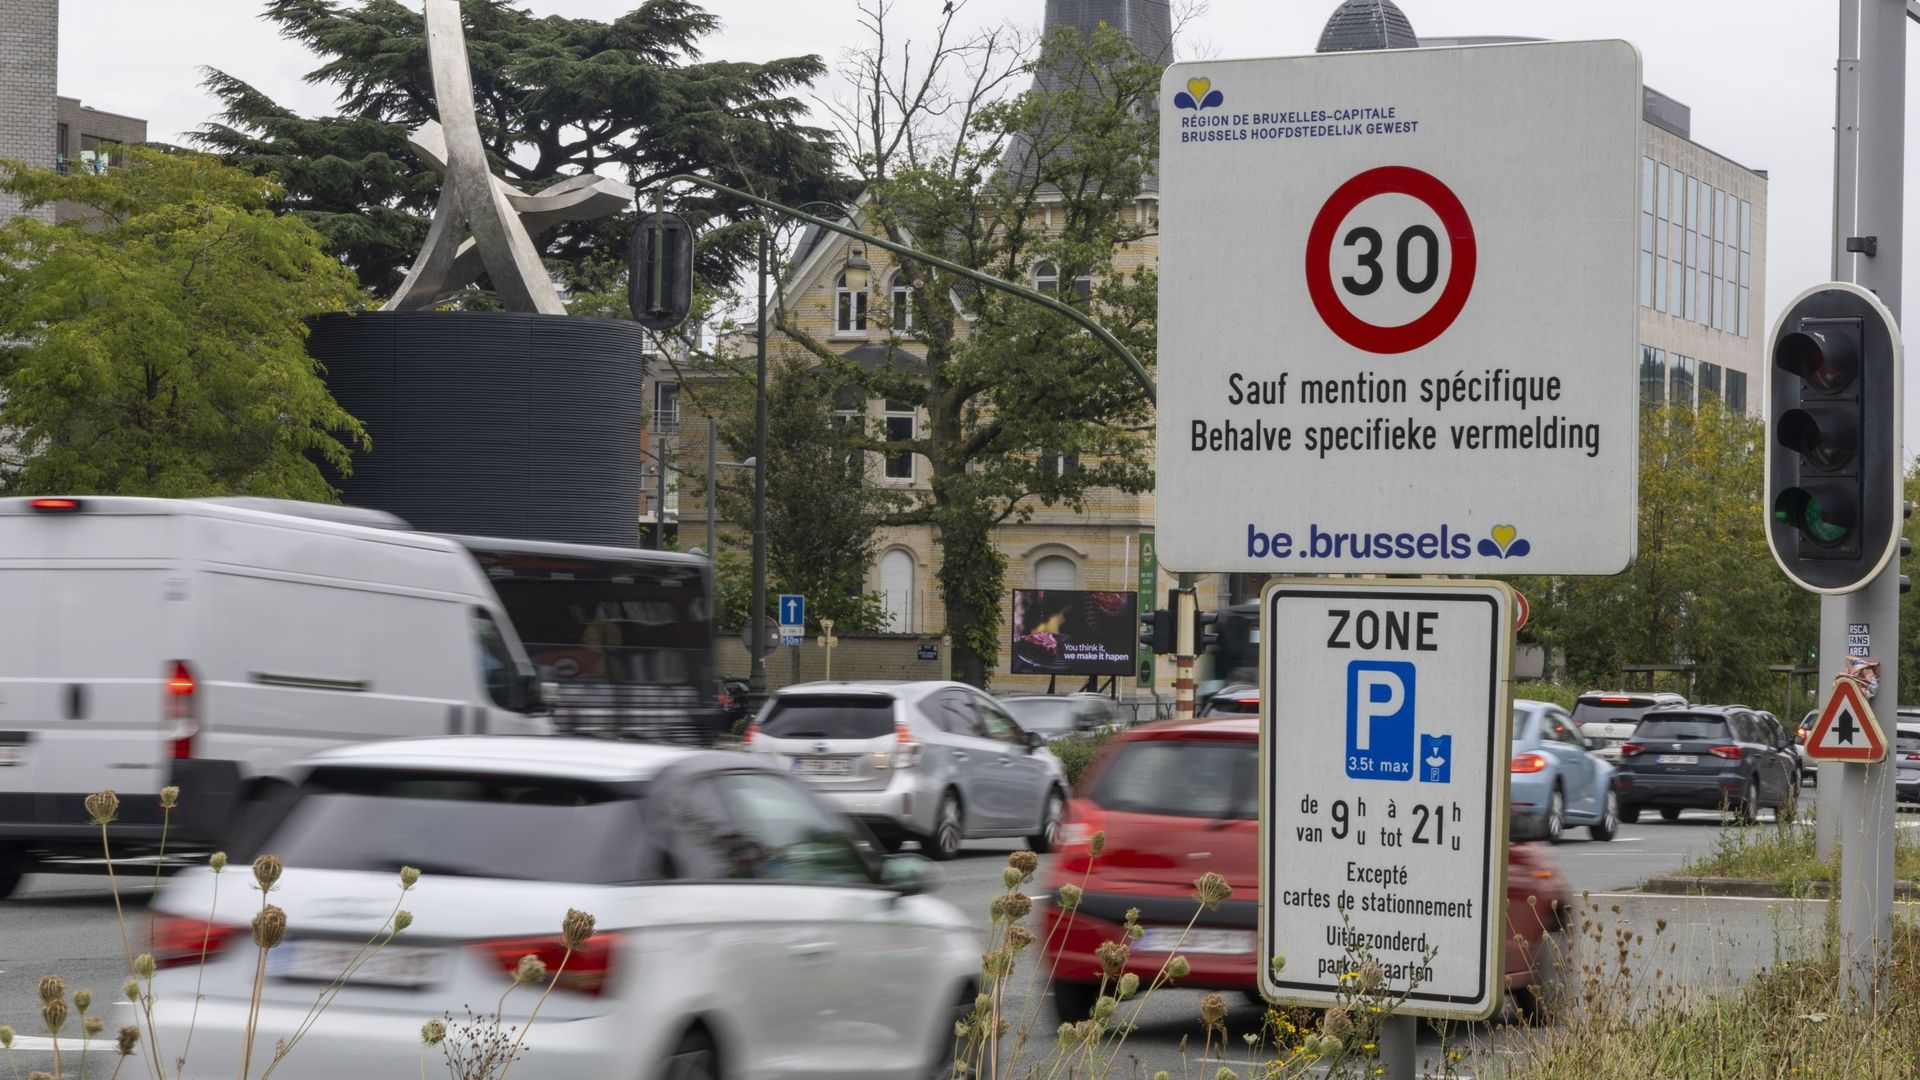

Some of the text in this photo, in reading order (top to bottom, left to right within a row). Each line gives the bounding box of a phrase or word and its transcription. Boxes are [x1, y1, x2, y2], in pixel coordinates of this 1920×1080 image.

[1181, 114, 1229, 128] RÉGION
[1233, 114, 1249, 126] DE
[1181, 121, 1419, 143] BRUSSELS HOOFDSTEDELIJK GEWEST
[1341, 224, 1439, 297] 30
[1228, 368, 1561, 410] Sauf mention spécifique
[1191, 415, 1600, 460] Behalve specifieke vermelding
[1247, 523, 1472, 560] be.brussels
[1327, 609, 1439, 652] ZONE
[1850, 625, 1868, 634] RSCA
[1850, 636, 1868, 645] FANS
[1064, 643, 1078, 651] You
[1079, 643, 1098, 651] think
[1077, 652, 1098, 660] make
[1099, 652, 1104, 660] it
[1105, 652, 1129, 662] hapen
[1850, 647, 1868, 656] AREA
[1356, 669, 1405, 751] P
[1348, 756, 1409, 773] 3.5t max
[1301, 793, 1461, 845] de 9 h à 21 h
[1296, 826, 1461, 851] van u tot u
[1347, 861, 1408, 889] Excepté
[1283, 889, 1473, 919] cartes de stationnement
[1326, 925, 1426, 953] Uitgezonderd
